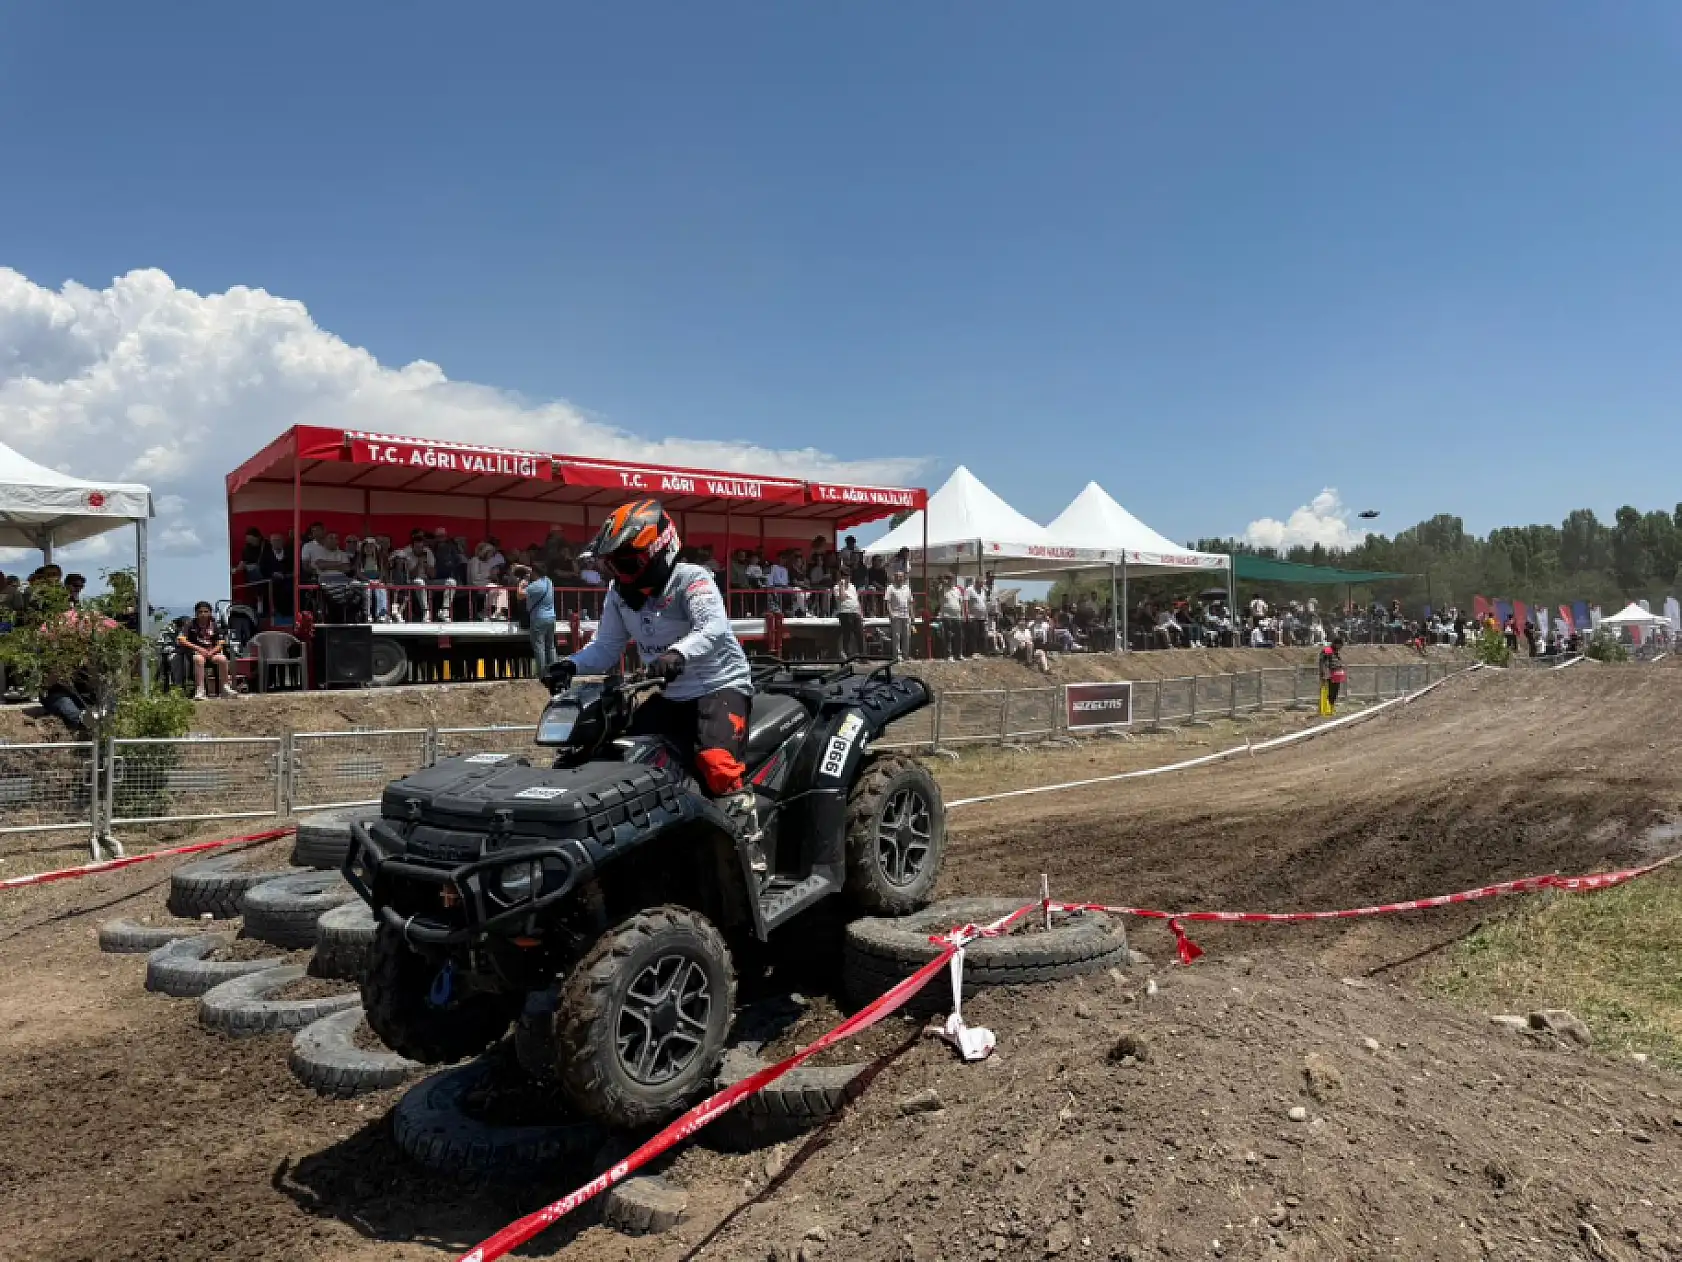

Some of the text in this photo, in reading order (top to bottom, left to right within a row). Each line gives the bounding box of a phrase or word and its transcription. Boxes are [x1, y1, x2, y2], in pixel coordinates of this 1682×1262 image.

[367, 444, 537, 478] T.C. AĞRI VALİLİĞİ
[619, 472, 761, 498] T.C. AĞRI VALİLİĞİ
[818, 487, 841, 500] T.C.
